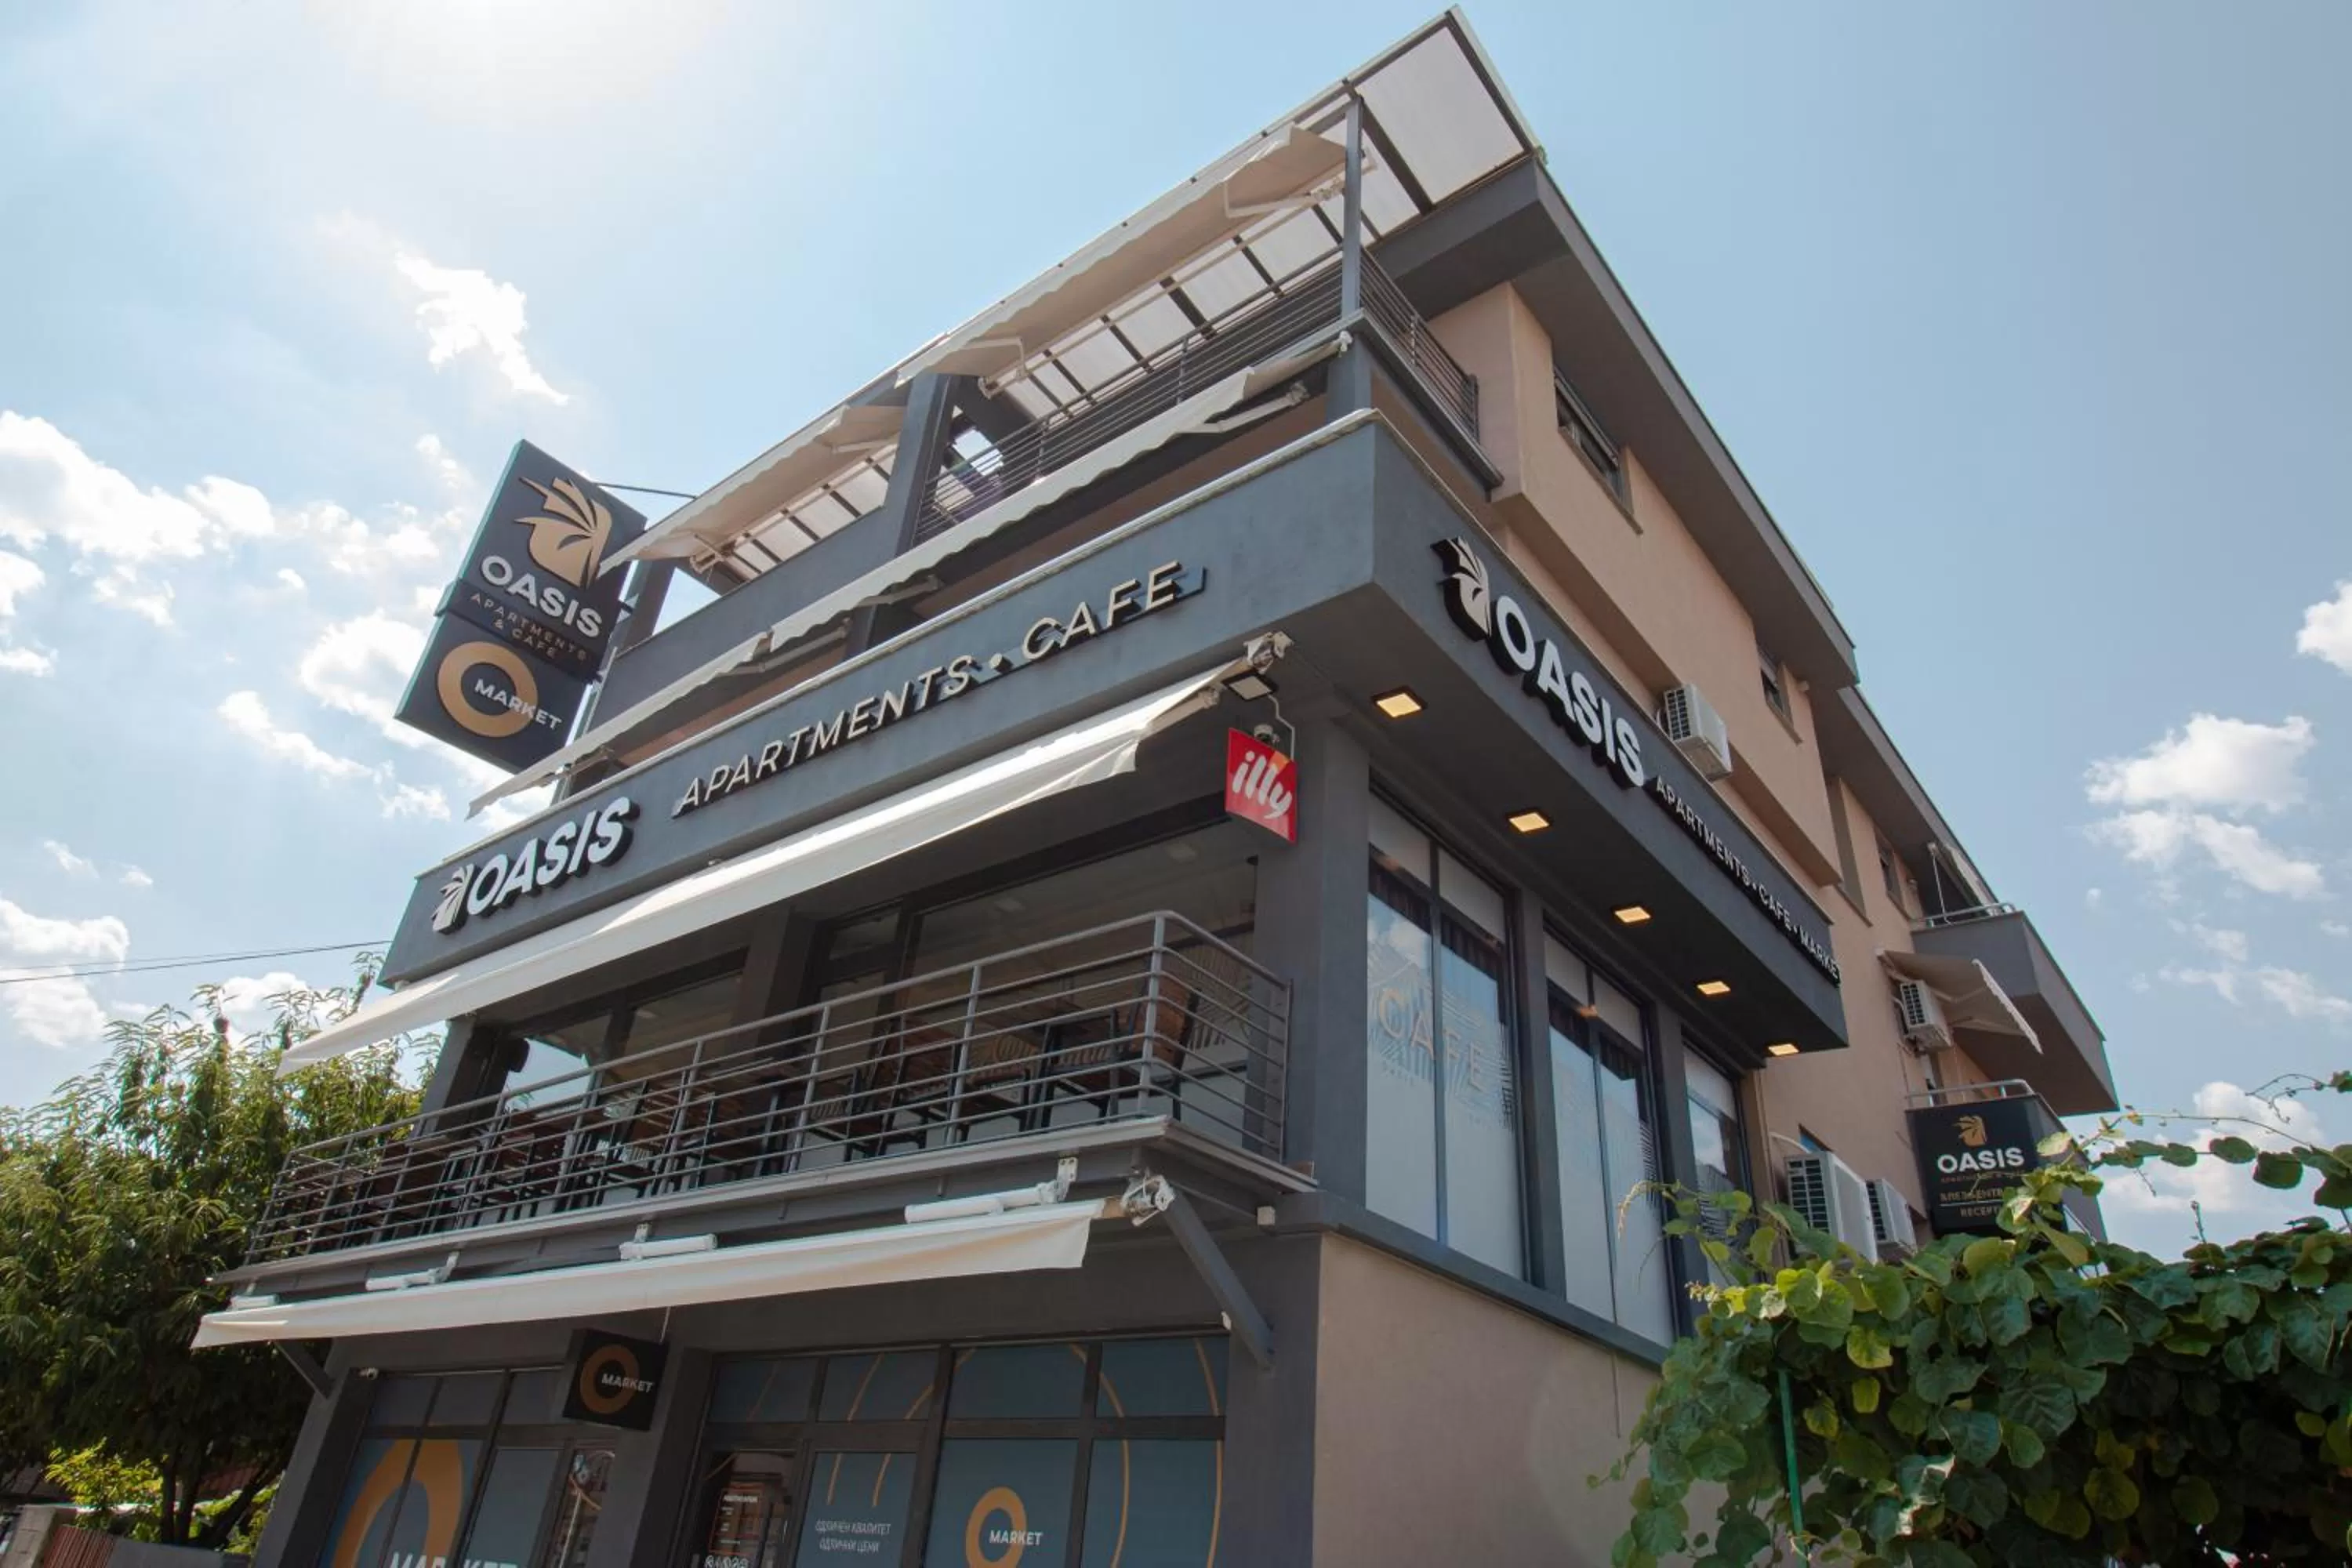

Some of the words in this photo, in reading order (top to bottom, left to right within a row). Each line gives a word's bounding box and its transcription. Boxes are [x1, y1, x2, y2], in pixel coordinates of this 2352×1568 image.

[471, 592, 587, 661] APARTMENTS
[479, 555, 603, 638] OASIS
[512, 628, 556, 659] CAFE
[474, 677, 562, 731] MARKET
[466, 796, 630, 916] OASIS
[676, 654, 974, 811] APARTMENTS
[1022, 561, 1181, 662] CAFE
[1232, 750, 1293, 819] illy
[1496, 595, 1644, 787] OASIS
[1656, 774, 1751, 887] APARTMENTS
[1759, 884, 1792, 931] CAFE
[1799, 925, 1841, 981] MARKE
[1937, 1147, 2024, 1174] OASIS
[601, 1373, 654, 1393] MARKET
[989, 1529, 1044, 1547] MARKET
